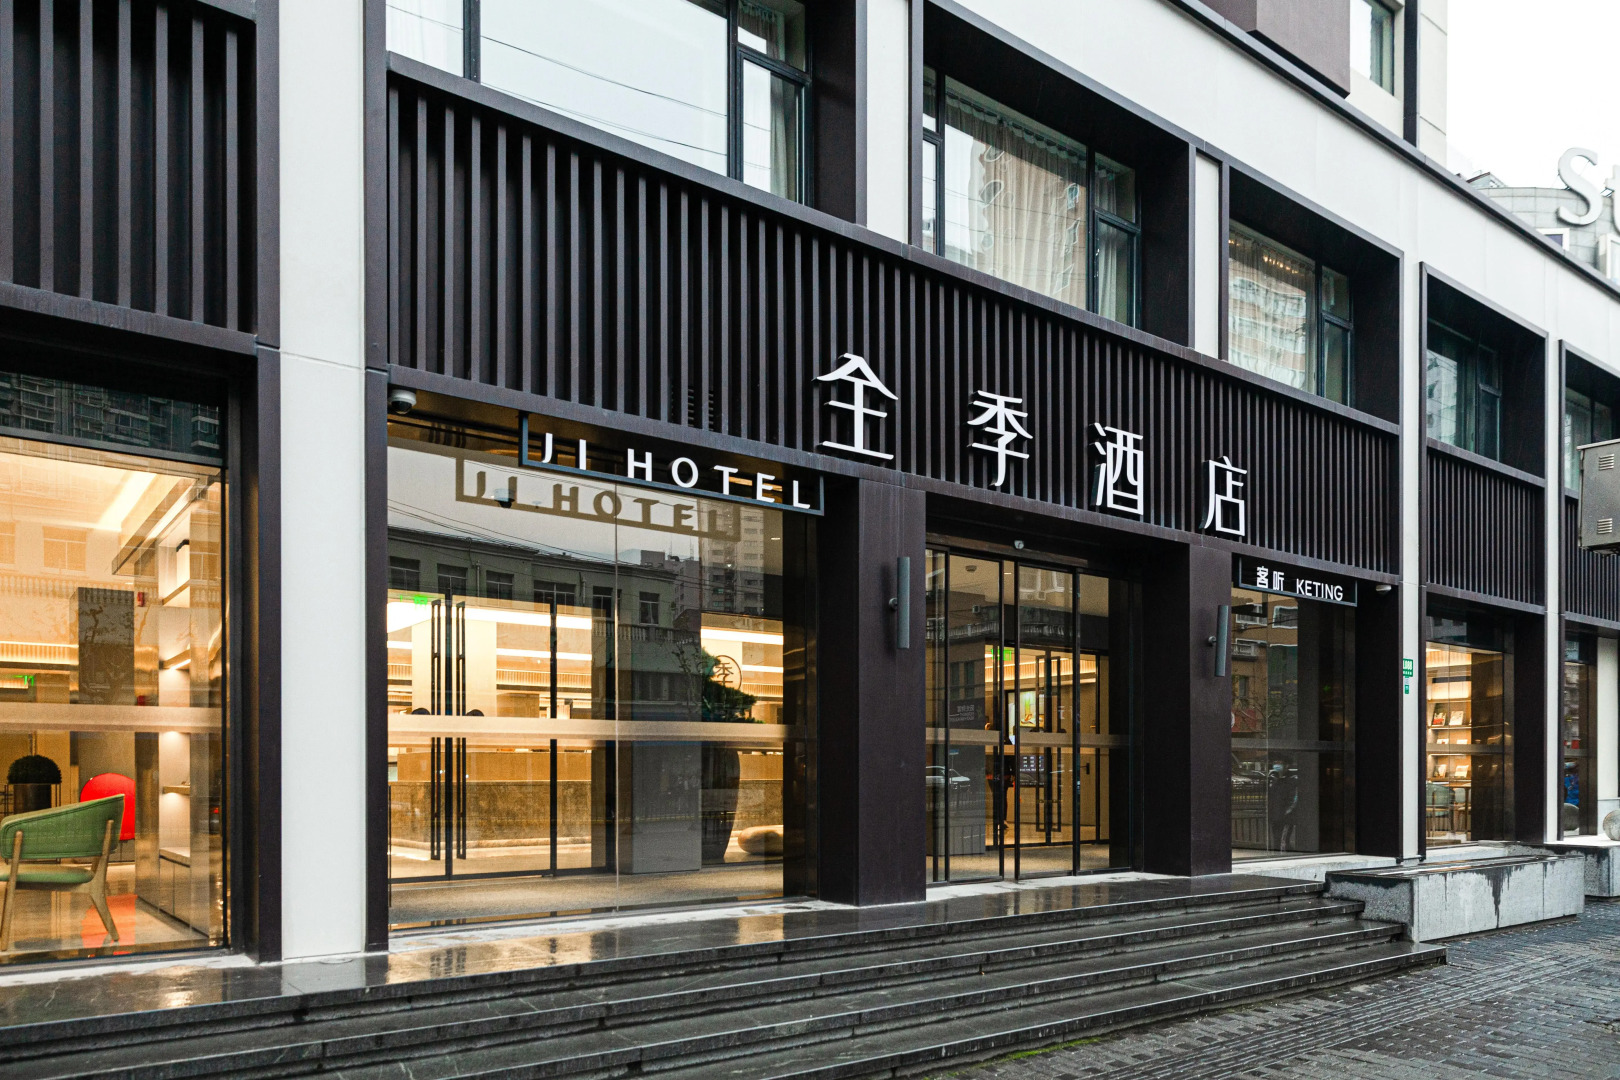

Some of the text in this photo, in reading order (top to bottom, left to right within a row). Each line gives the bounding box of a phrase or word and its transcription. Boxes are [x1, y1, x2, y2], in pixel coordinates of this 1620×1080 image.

[541, 433, 810, 509] JI HOTEL
[817, 353, 1247, 536] 全季酒店
[1296, 578, 1343, 601] KETING
